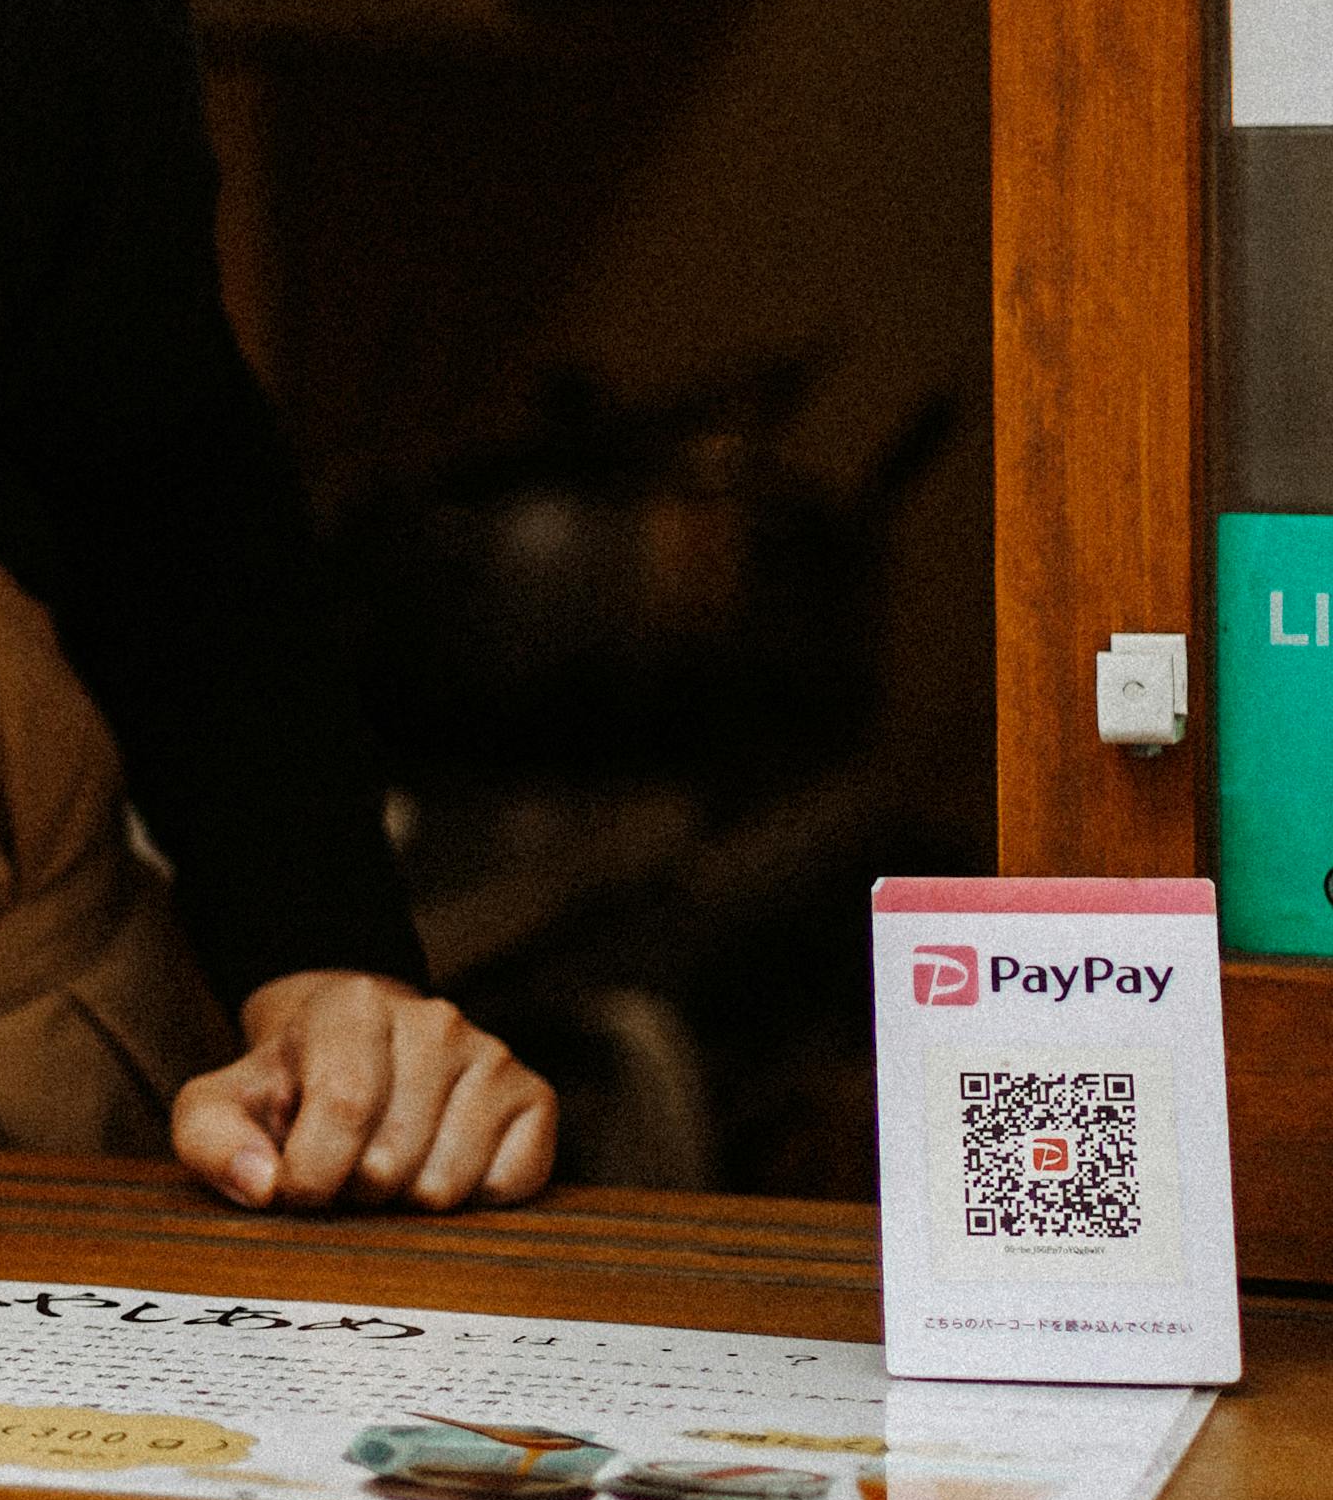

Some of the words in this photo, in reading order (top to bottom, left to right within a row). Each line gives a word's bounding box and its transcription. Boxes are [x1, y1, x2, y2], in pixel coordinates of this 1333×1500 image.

[990, 956, 1174, 1002] PayPay
[923, 1315, 1195, 1336] こちらのバーコードを読み込んでください
